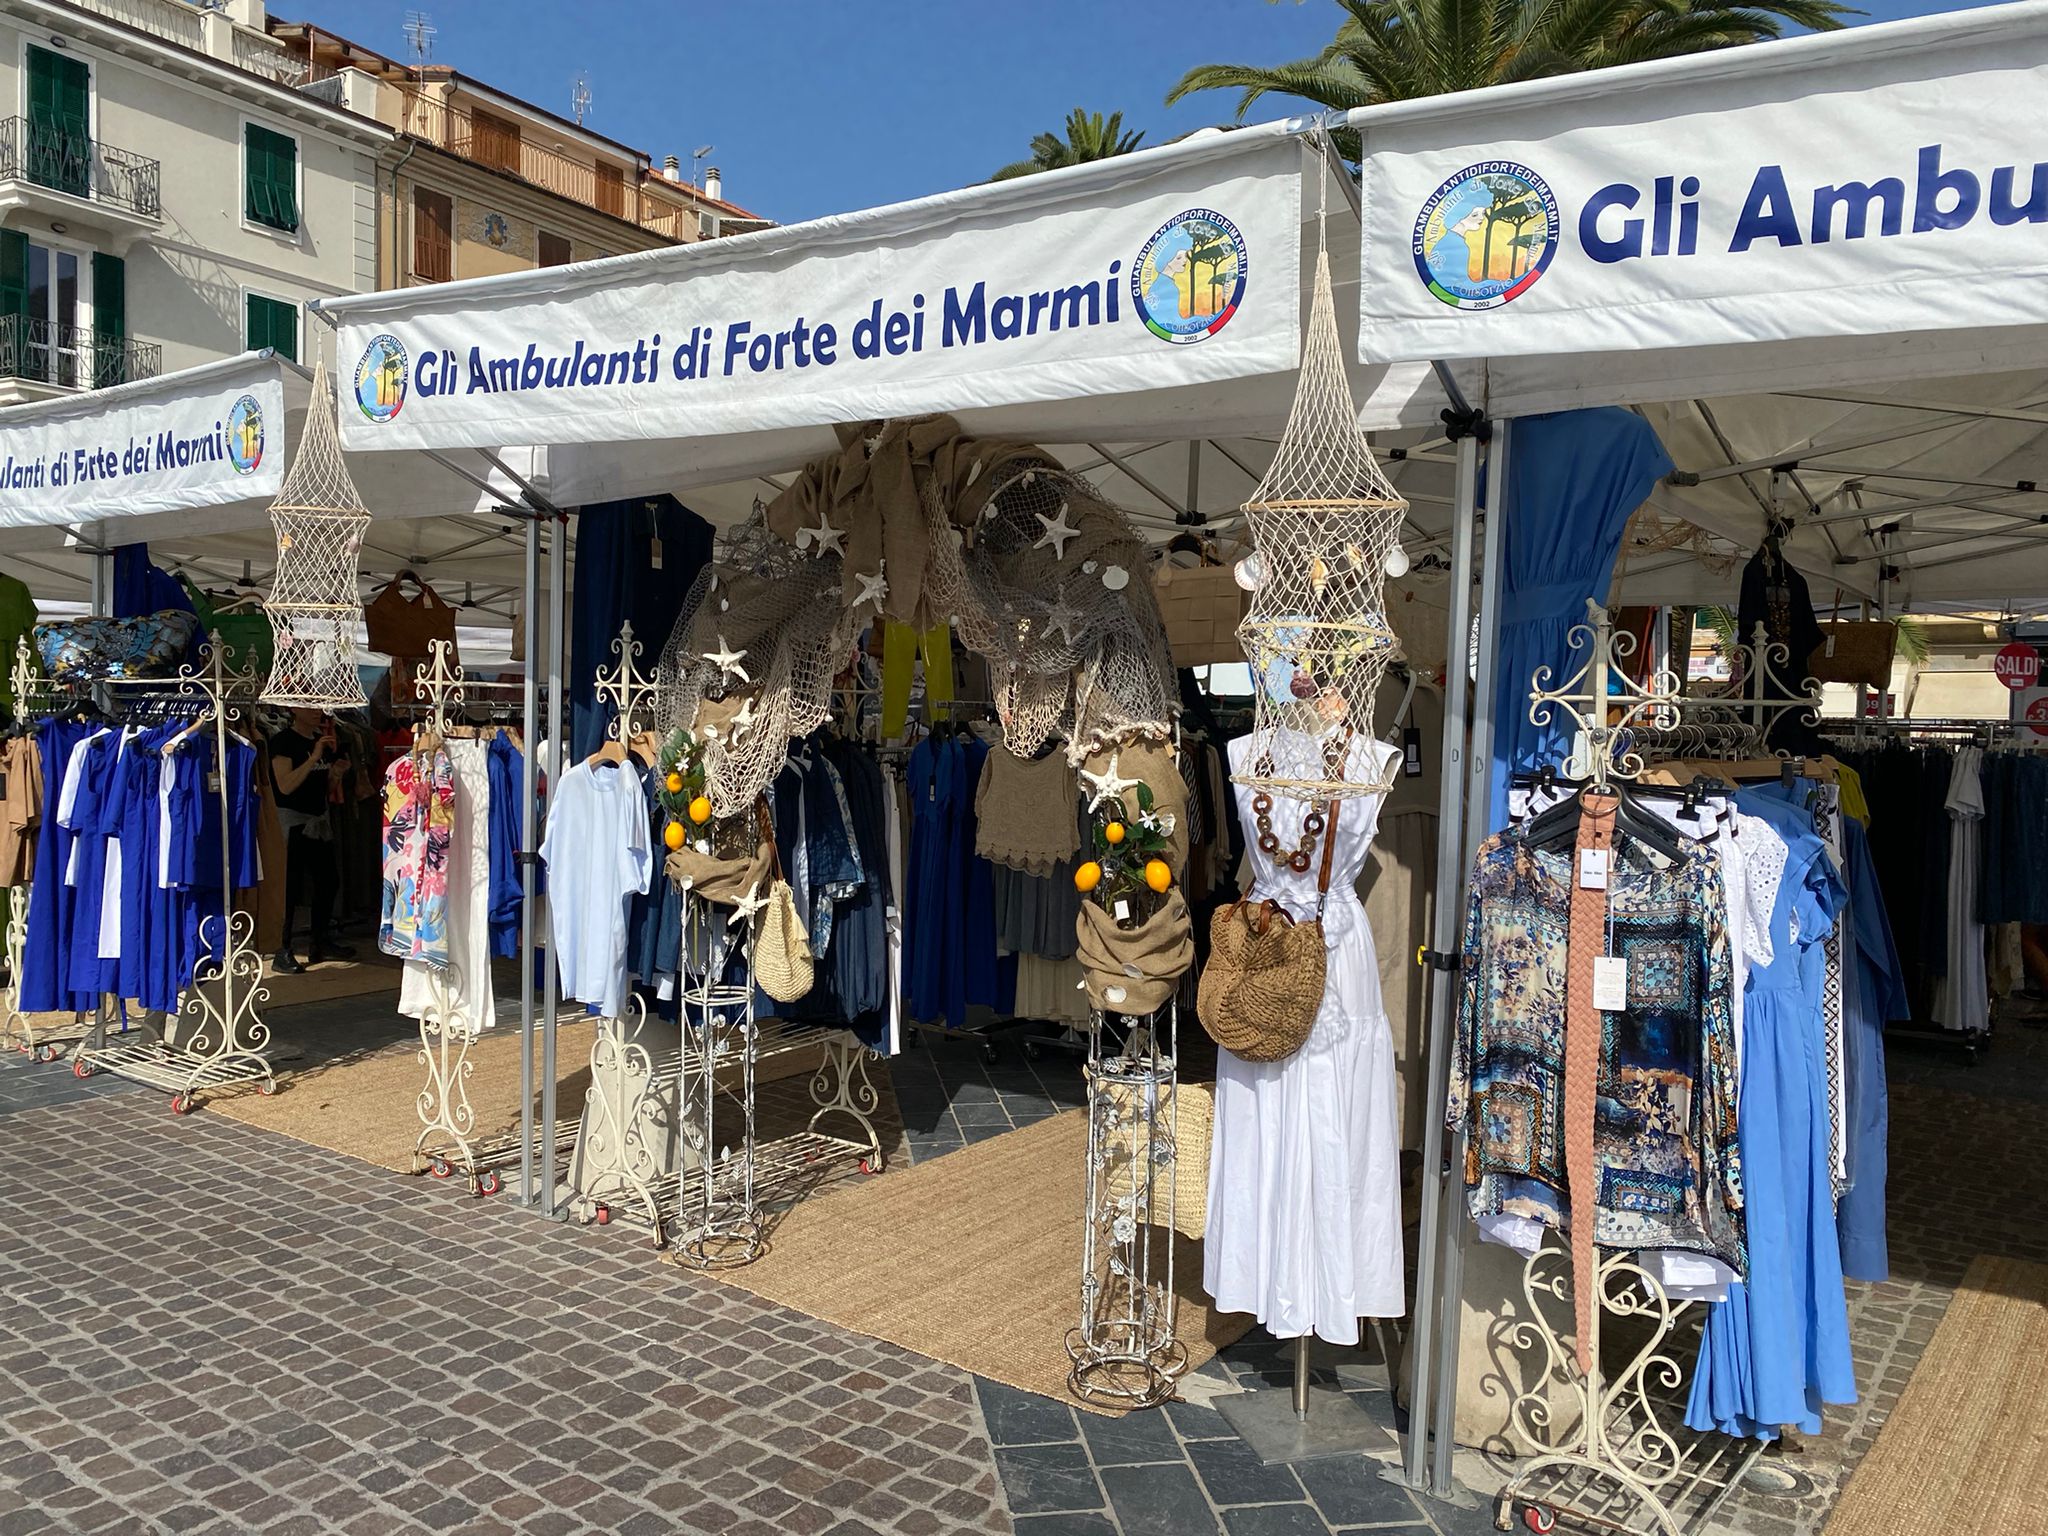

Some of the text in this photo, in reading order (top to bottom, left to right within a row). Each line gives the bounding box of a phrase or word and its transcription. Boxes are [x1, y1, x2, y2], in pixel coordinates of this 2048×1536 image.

[1413, 162, 1558, 255] GLIAMBULANTIDIFORTEDEIMARMI.IT
[1578, 144, 2048, 264] Gli Ambu
[1132, 210, 1247, 297] GLIAMBULANTIDIFORTEDEIMARMI.IT
[414, 260, 1121, 398] Gli Ambulanti di Forte dei Marmi
[51, 452, 68, 487] di
[123, 436, 151, 475] dei
[1996, 656, 2038, 676] SALDI
